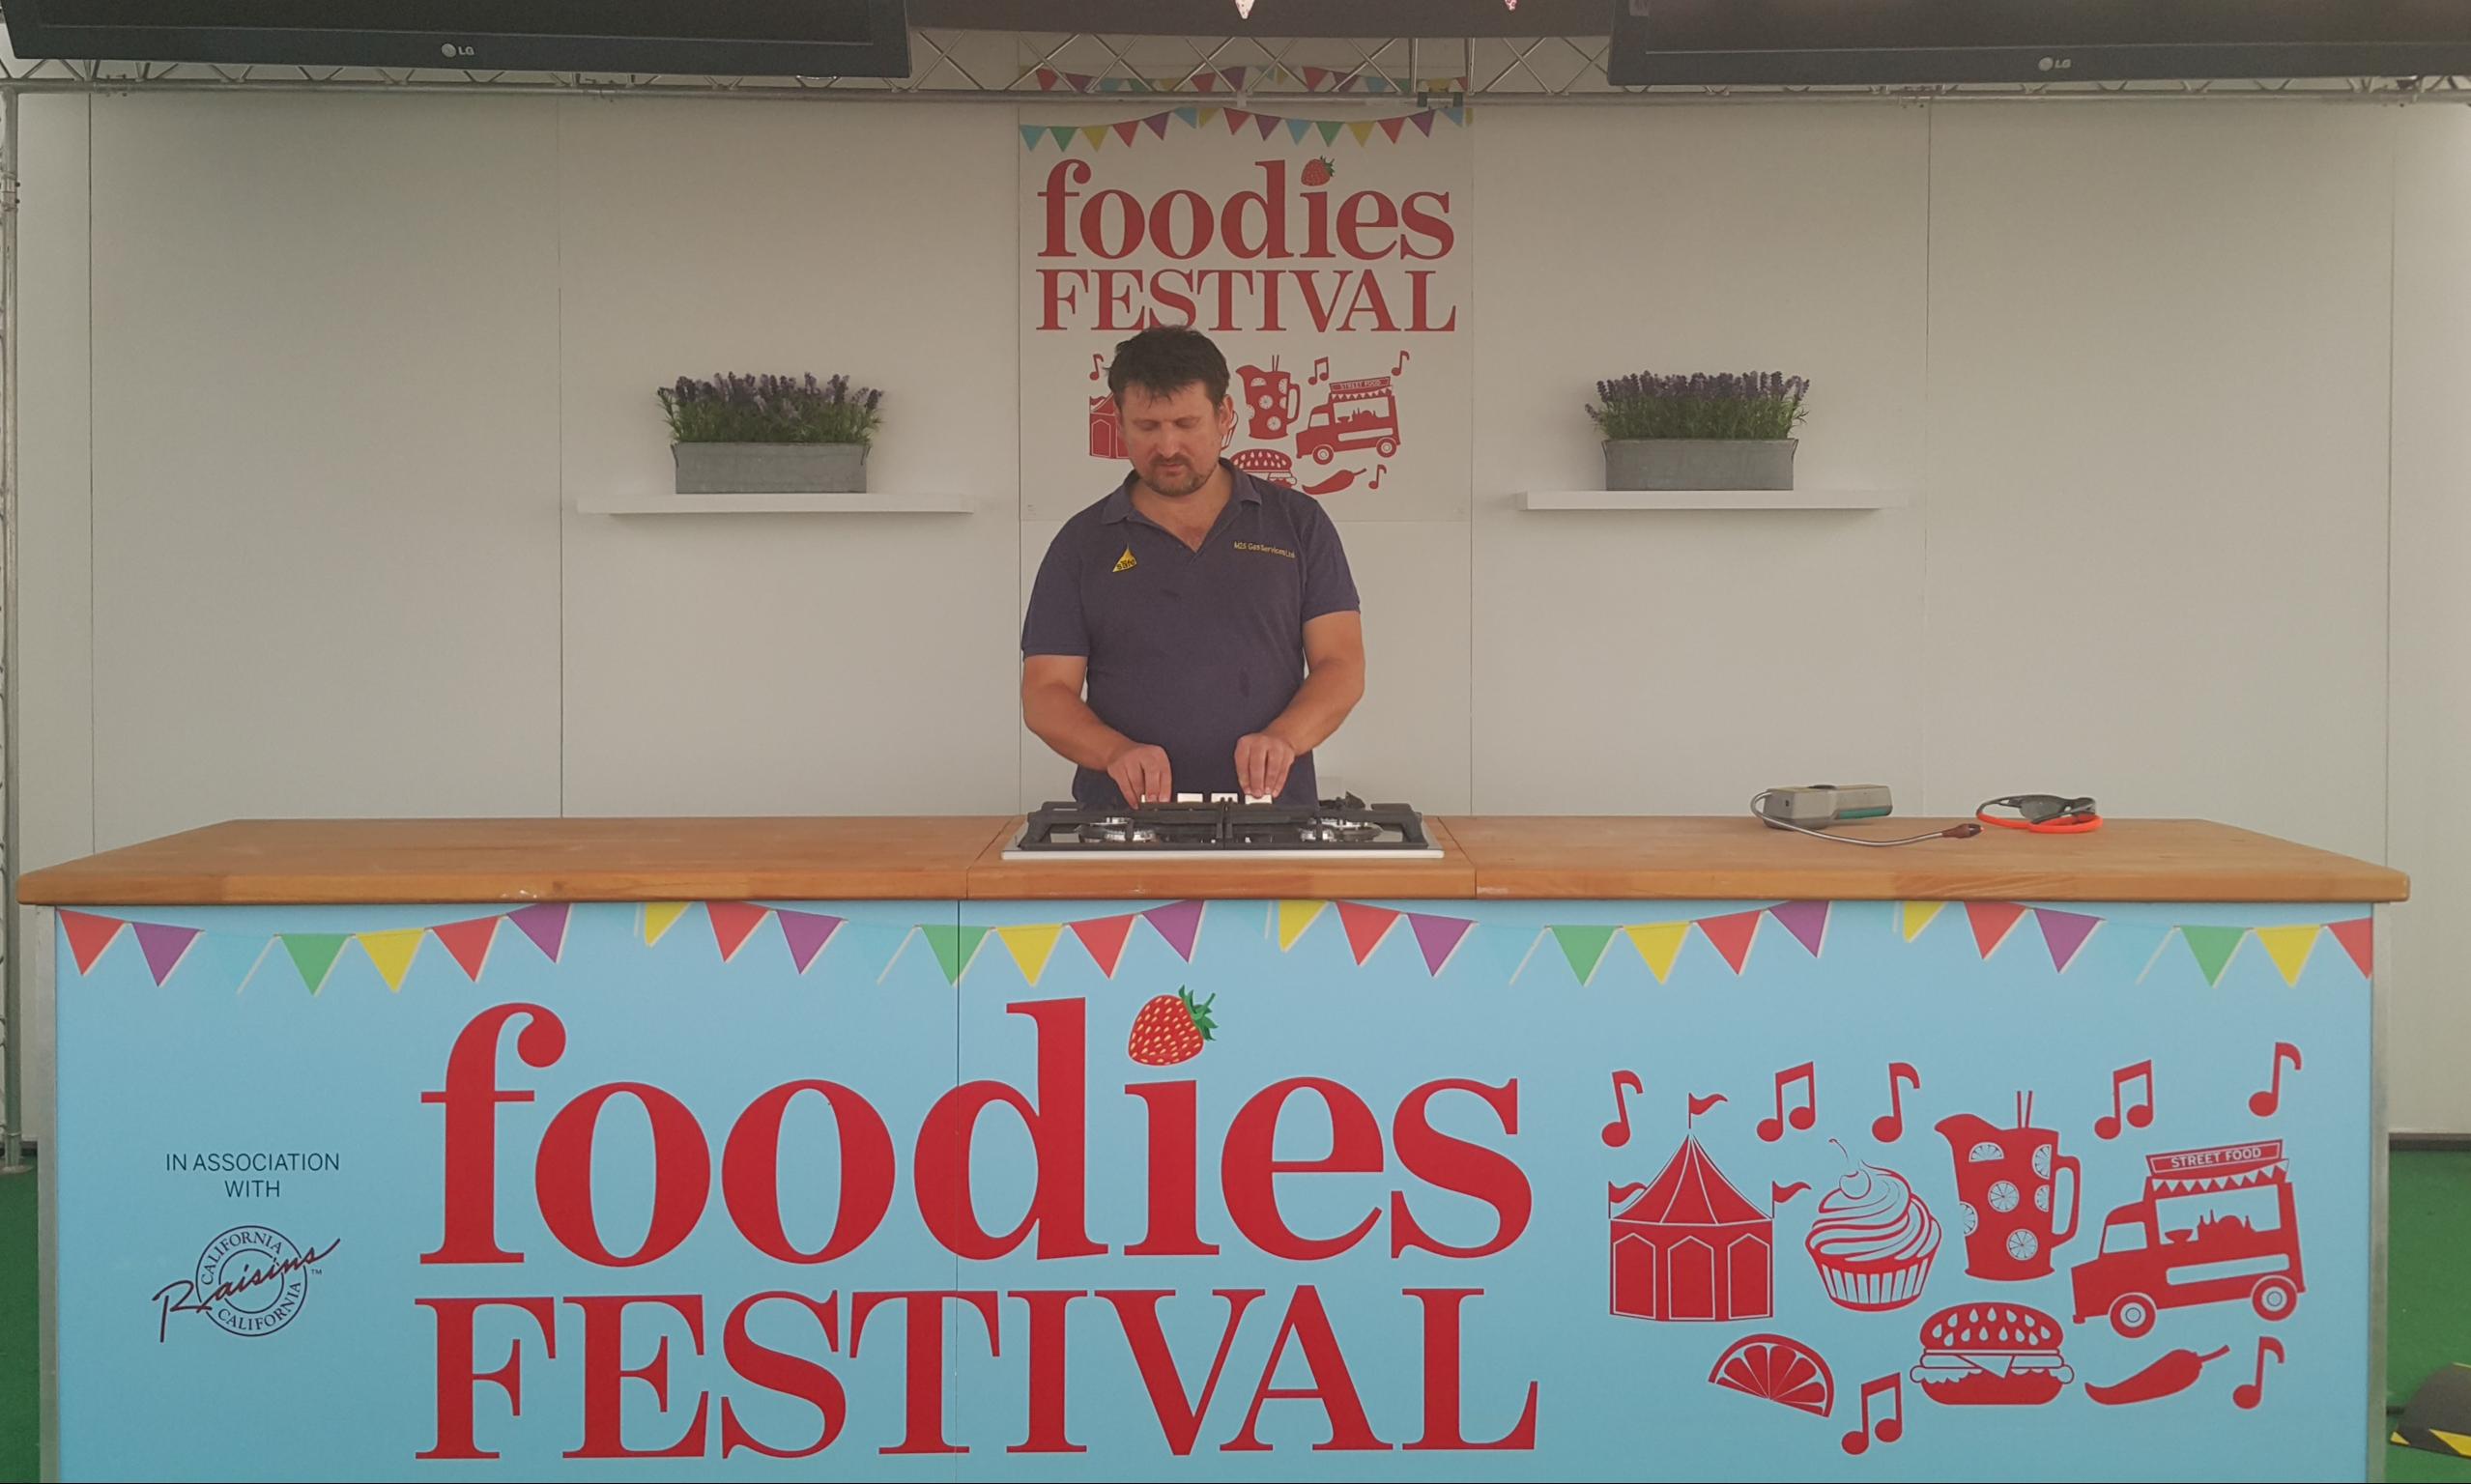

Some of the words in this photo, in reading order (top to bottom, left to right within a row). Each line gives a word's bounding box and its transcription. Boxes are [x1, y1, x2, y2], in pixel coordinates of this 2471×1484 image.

[458, 45, 474, 56] LG
[2054, 58, 2072, 69] LG
[1037, 158, 1454, 262] foodies
[1037, 268, 1457, 334] FESTIVAL
[419, 995, 1534, 1269] foodies
[2170, 1152, 2221, 1168] STREET
[2226, 1147, 2262, 1161] FOOD
[166, 1153, 187, 1171] IN
[193, 1153, 340, 1172] ASSOCIATION
[224, 1180, 280, 1198] WITH
[200, 1231, 283, 1286] CALIFORNIA
[152, 1239, 341, 1343] Raisins
[217, 1280, 302, 1331] CALIFORNIA
[415, 1287, 1538, 1461] FESTIVAL
